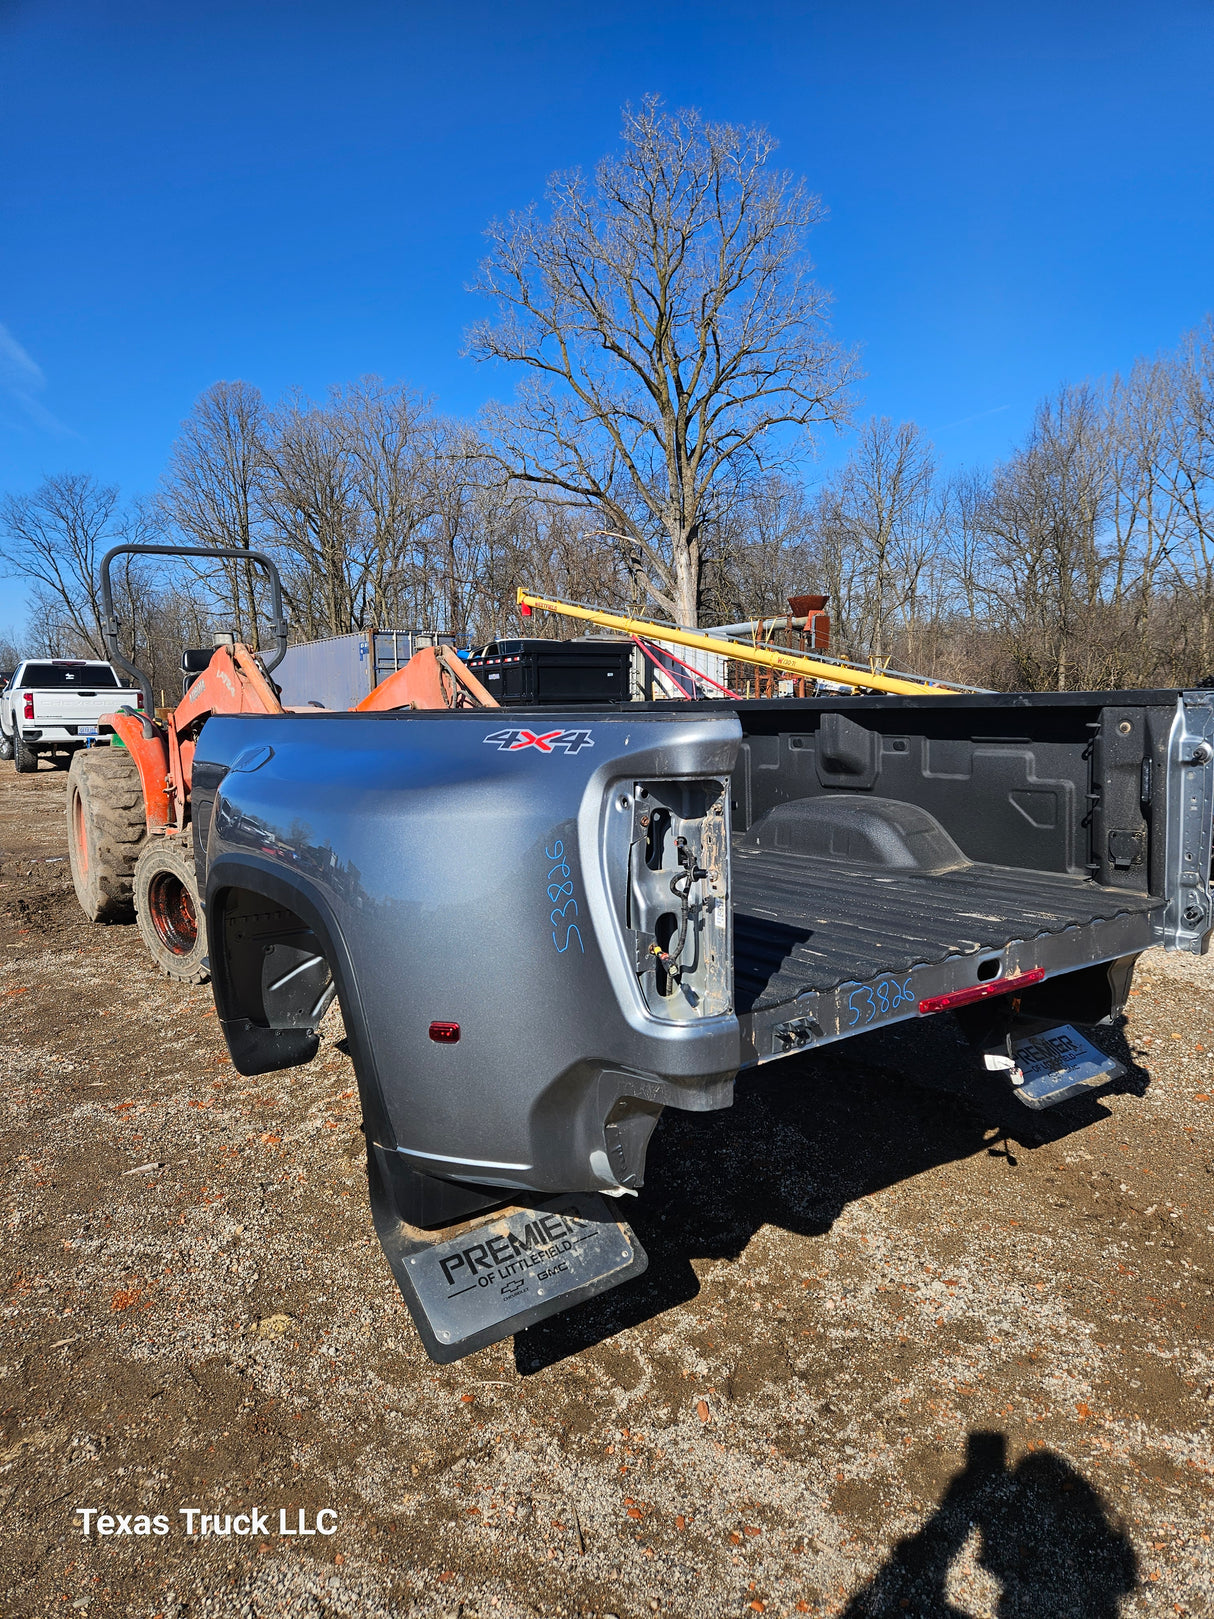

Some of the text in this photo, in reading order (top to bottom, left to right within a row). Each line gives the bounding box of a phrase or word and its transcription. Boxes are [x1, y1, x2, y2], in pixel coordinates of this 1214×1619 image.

[545, 840, 585, 954] 53826
[848, 977, 915, 1026] 53826
[438, 1206, 589, 1286] PREMIER
[477, 1240, 573, 1288] OF LITTLEFIELD
[537, 1261, 569, 1282] GMC
